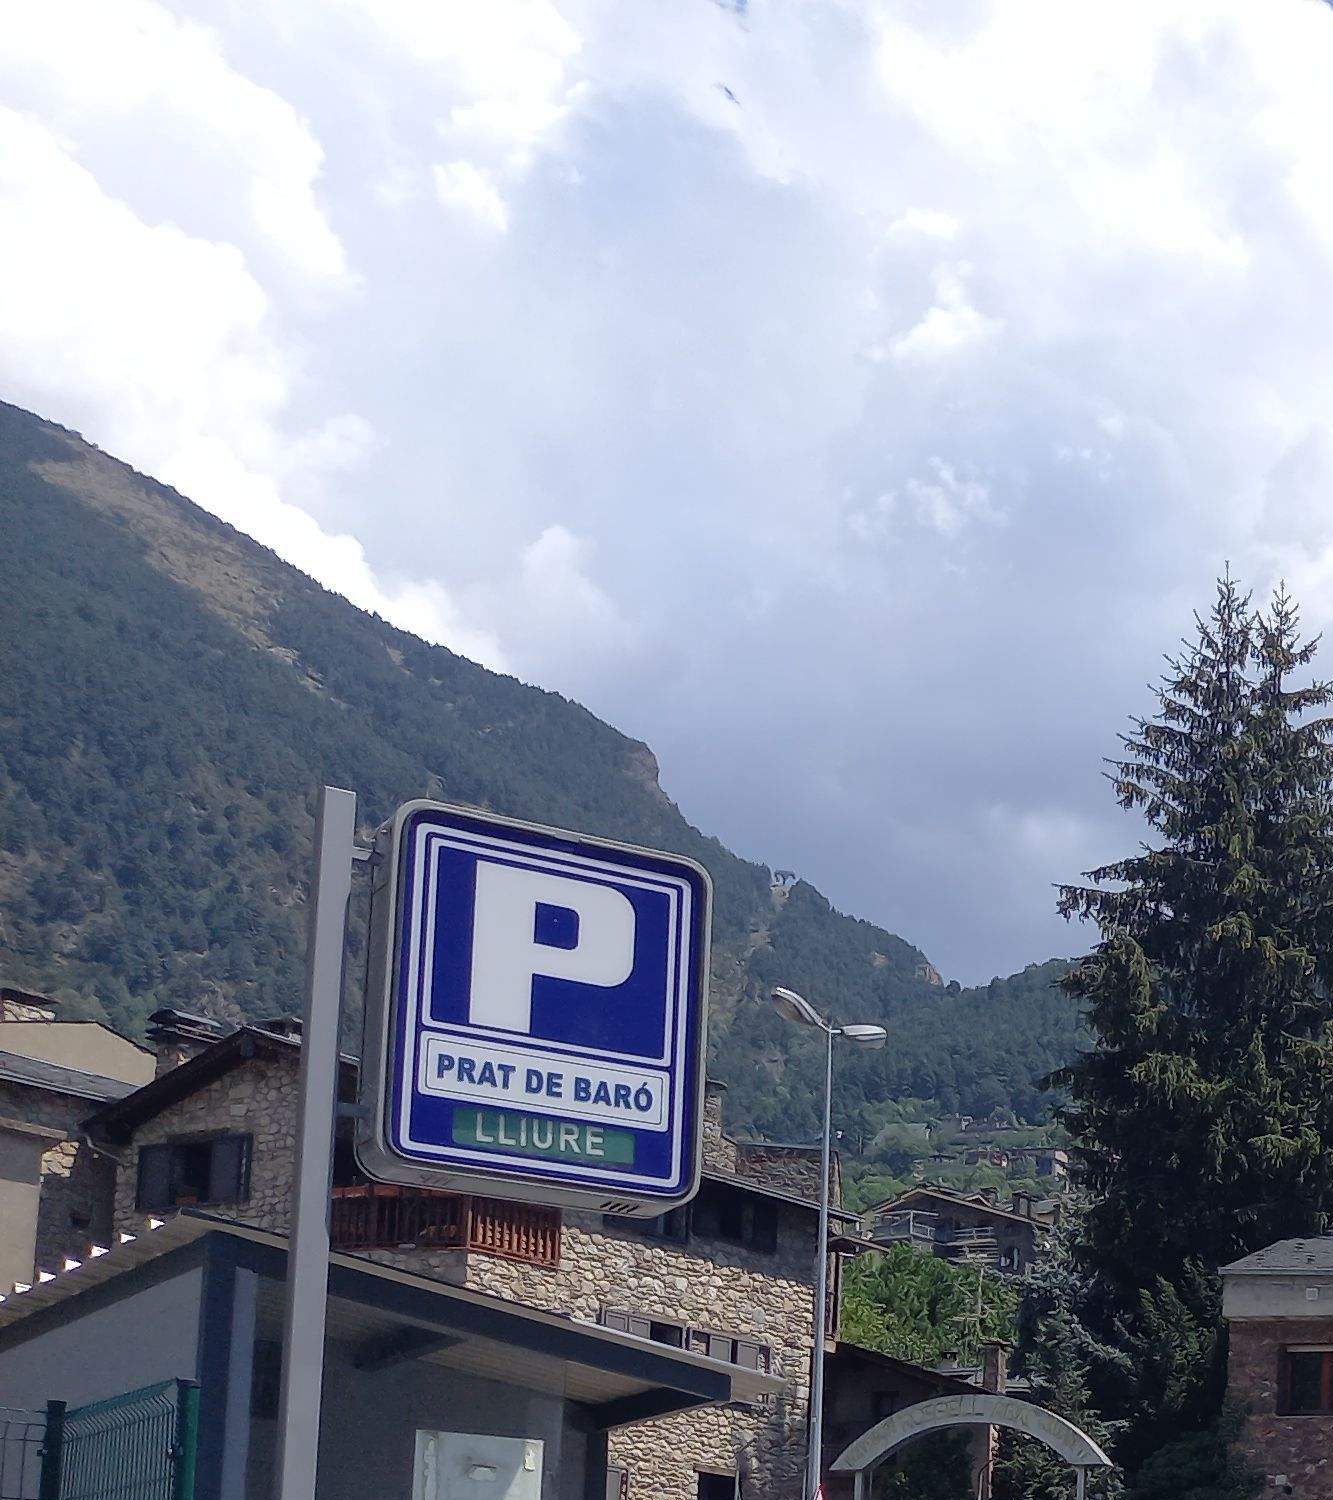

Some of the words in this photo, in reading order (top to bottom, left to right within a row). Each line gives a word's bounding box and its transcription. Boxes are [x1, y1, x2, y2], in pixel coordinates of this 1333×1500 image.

[470, 860, 636, 1034] P
[436, 1053, 516, 1090] PRAT
[525, 1068, 564, 1099] DE
[573, 1081, 654, 1113] BARÓ
[475, 1112, 606, 1157] LLIURE
